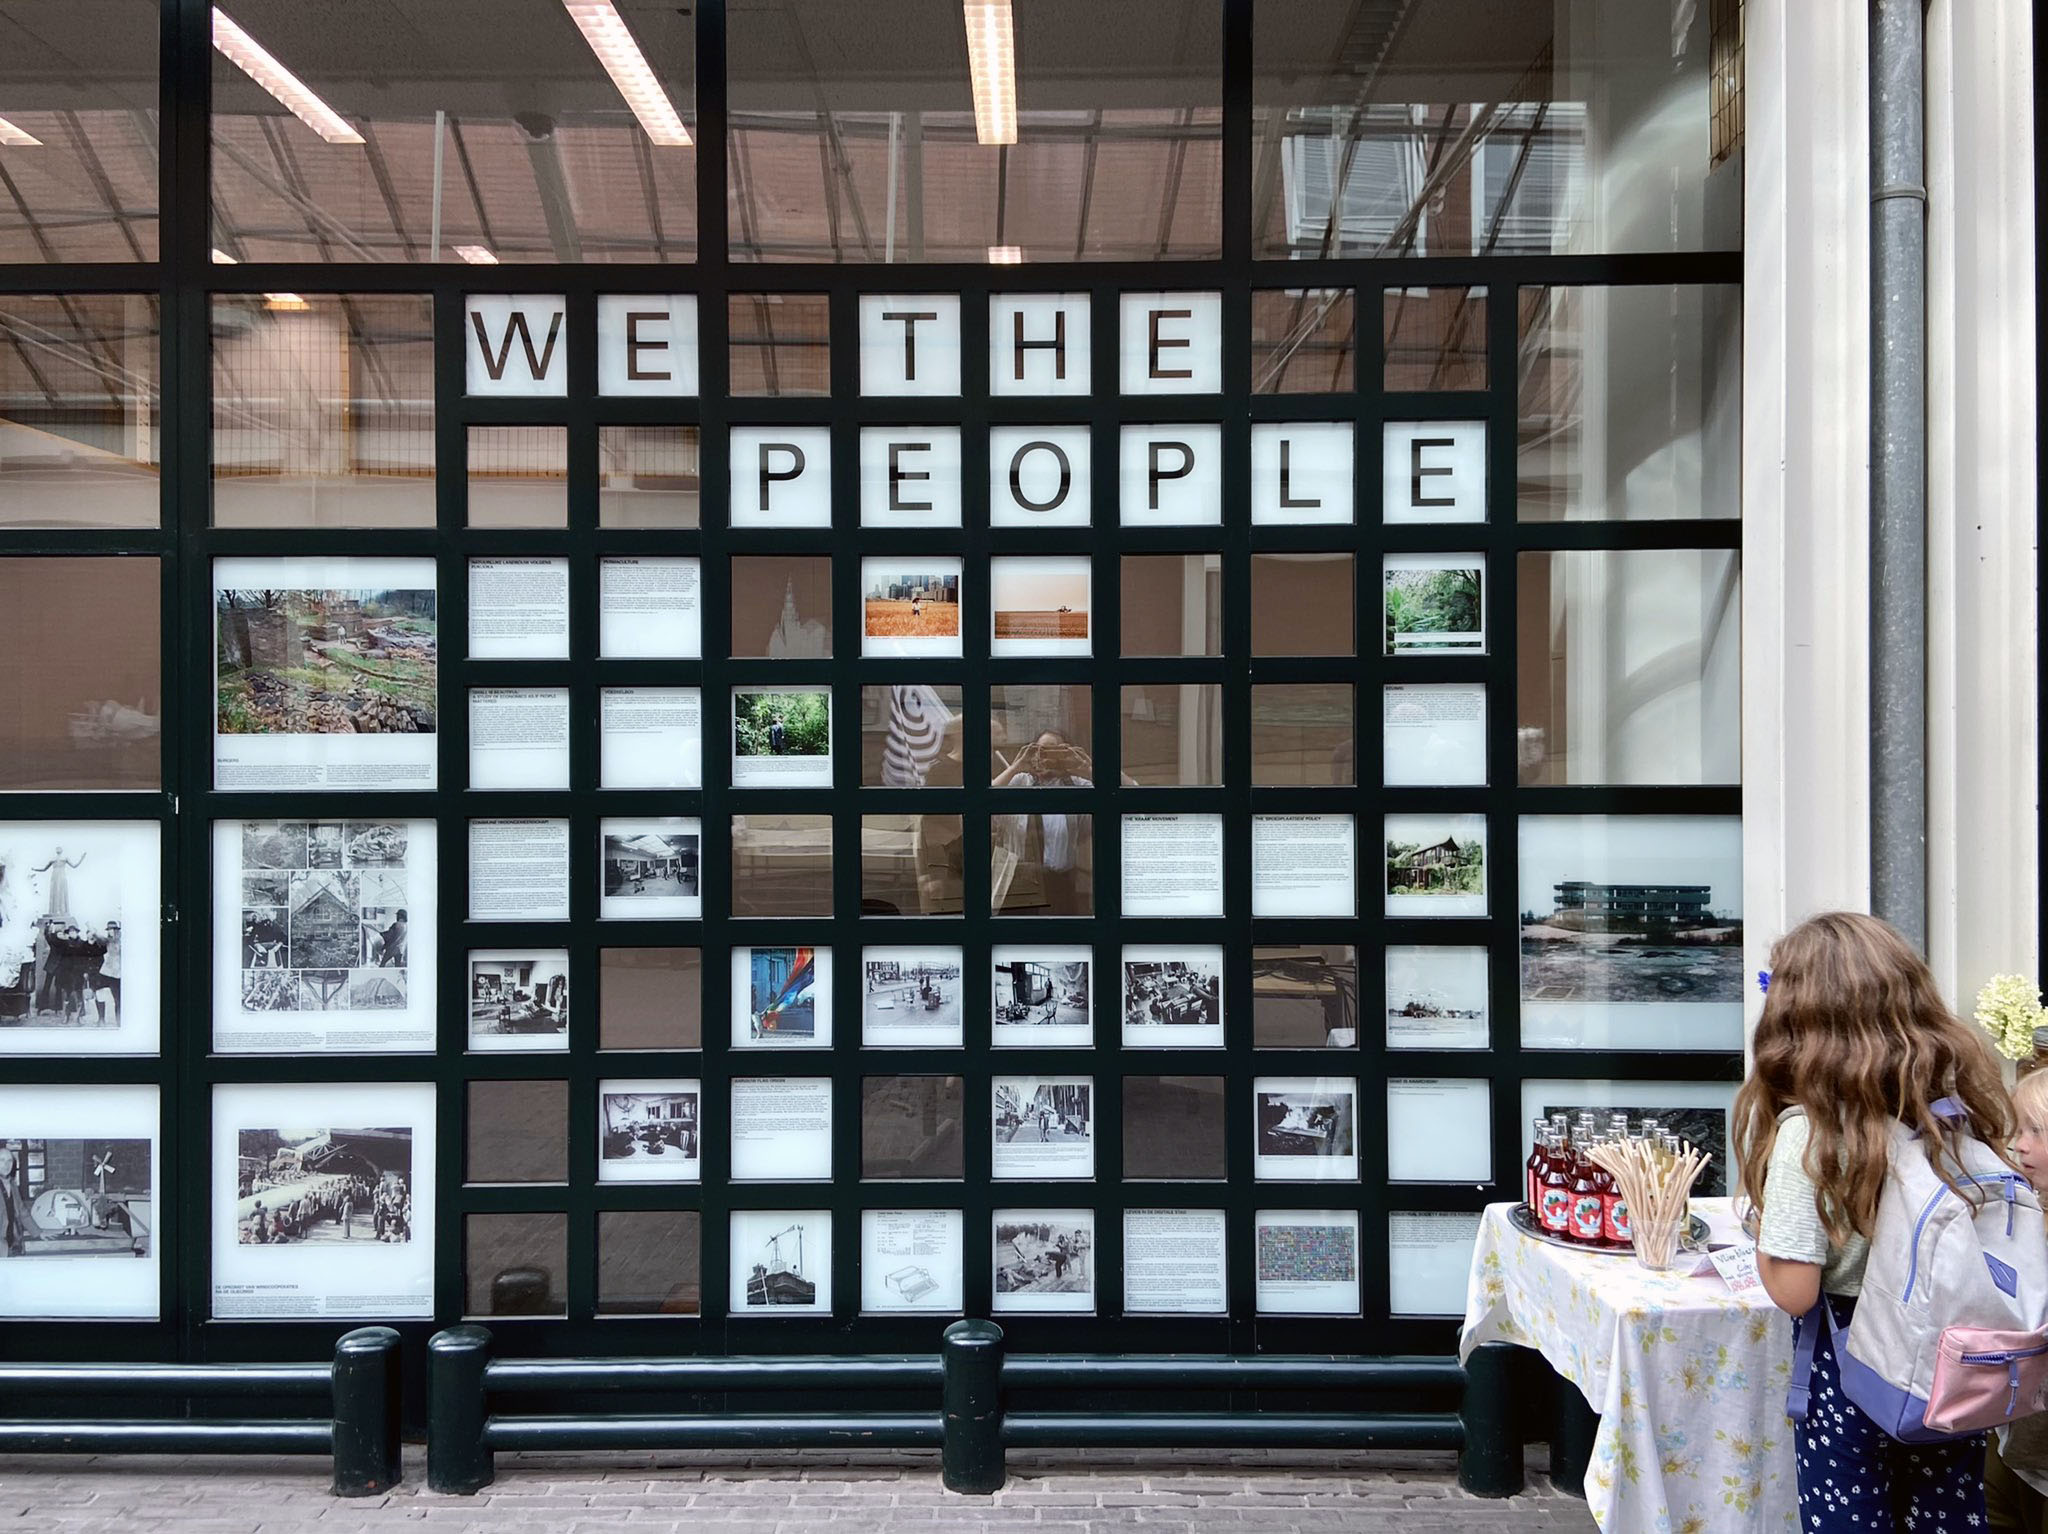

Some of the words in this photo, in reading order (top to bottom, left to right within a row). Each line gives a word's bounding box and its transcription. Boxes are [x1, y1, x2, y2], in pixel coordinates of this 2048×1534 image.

[470, 311, 672, 381] WE
[882, 309, 1193, 381] THE
[759, 437, 1456, 512] PEOPLE
